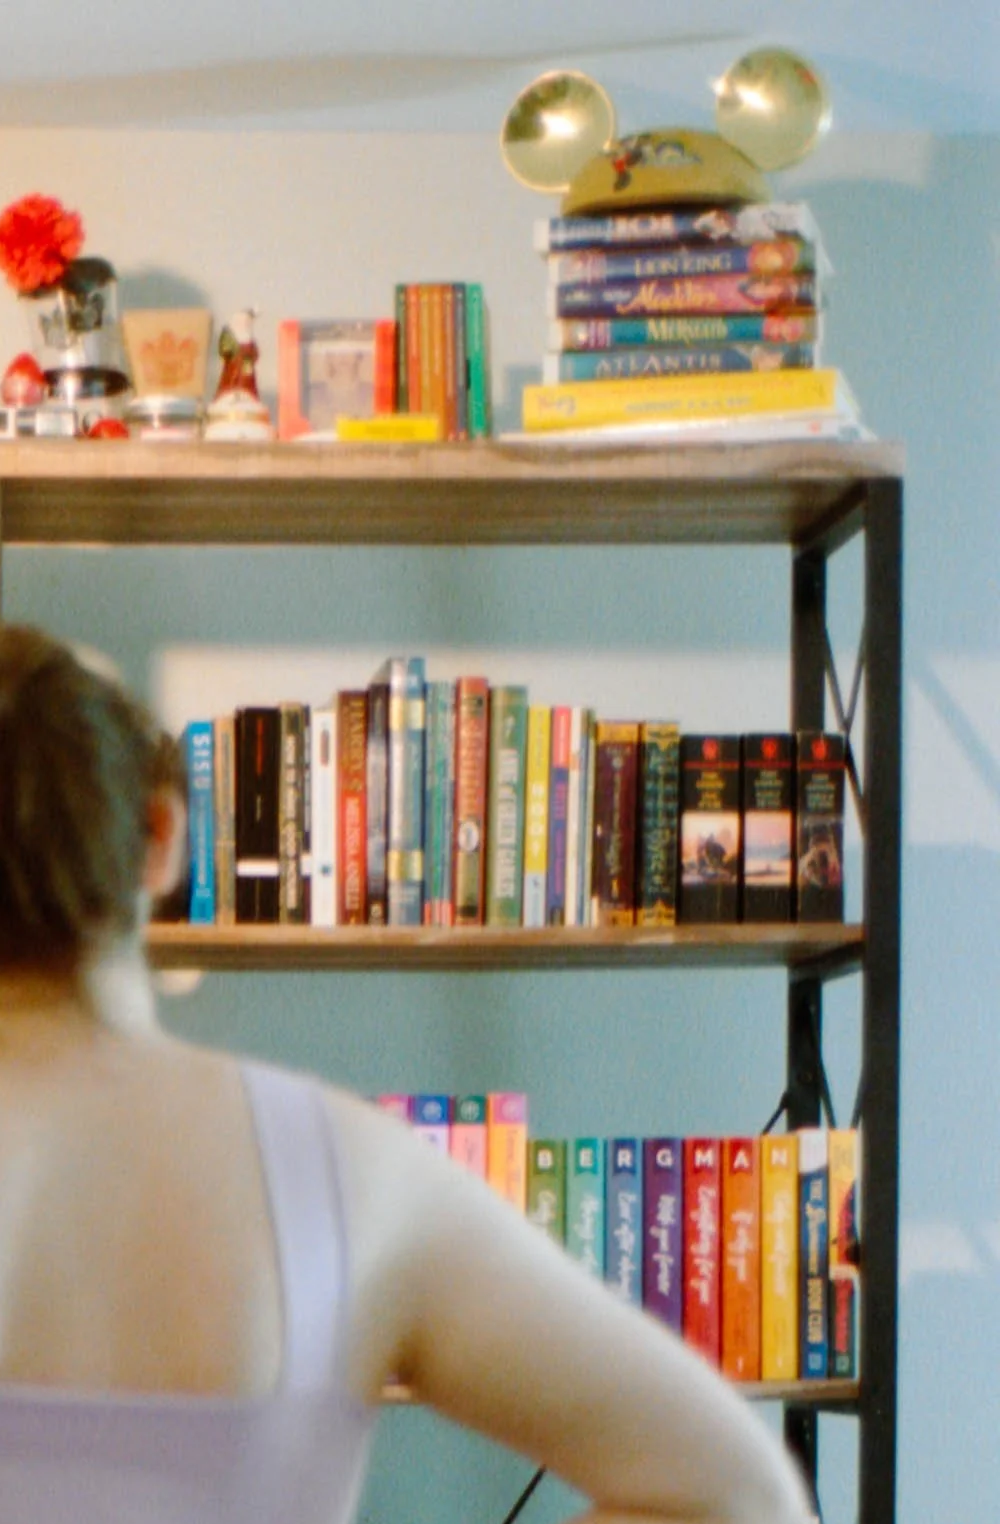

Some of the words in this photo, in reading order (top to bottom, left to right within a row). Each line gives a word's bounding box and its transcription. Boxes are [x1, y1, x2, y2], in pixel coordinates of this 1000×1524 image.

[635, 256, 677, 277] LION
[810, 1180, 823, 1200] THE
[808, 1313, 823, 1344] CLUB
